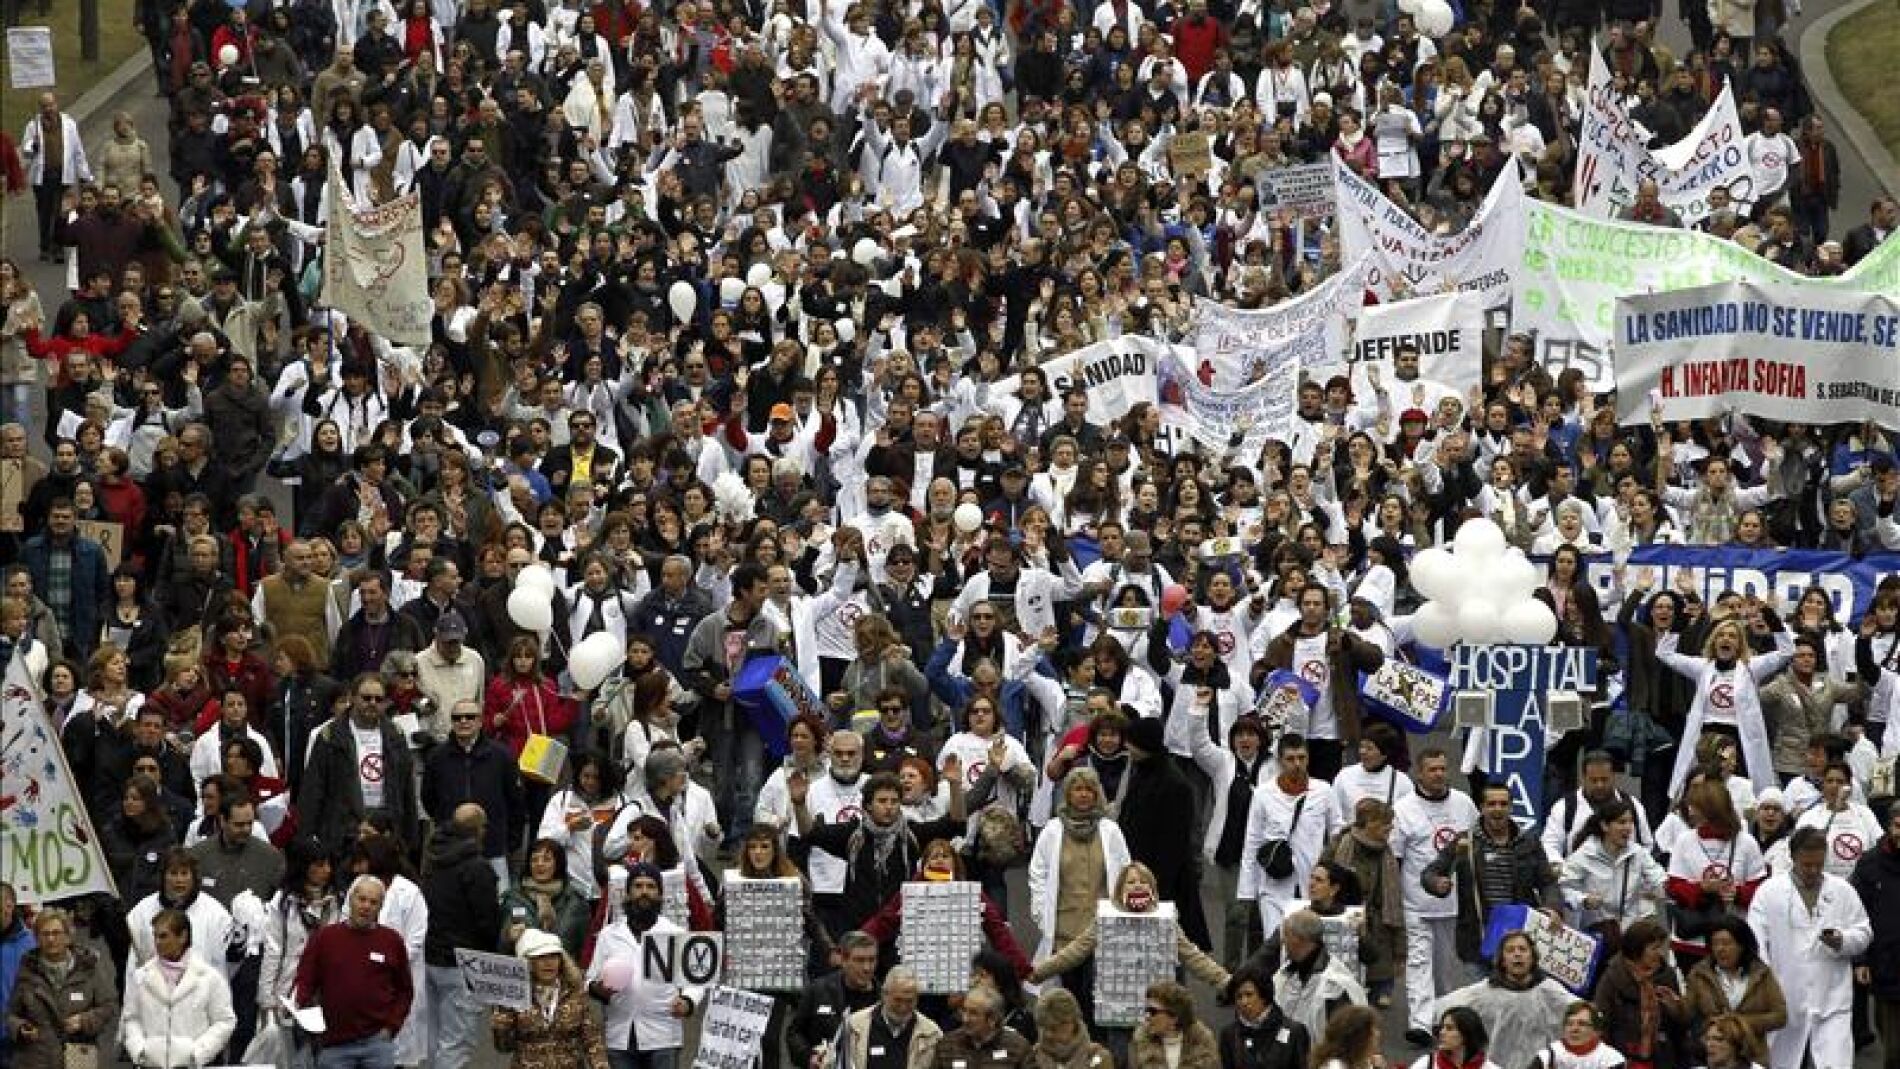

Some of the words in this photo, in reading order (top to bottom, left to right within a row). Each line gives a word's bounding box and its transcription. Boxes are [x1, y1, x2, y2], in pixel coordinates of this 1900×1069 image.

[1627, 315, 1649, 344] LA
[1653, 303, 1737, 341] SANIDAD
[1743, 301, 1767, 334] NO
[1773, 306, 1796, 338] SE
[1801, 308, 1868, 345] VENDE,
[1874, 315, 1899, 348] SE
[1661, 365, 1680, 398] H.
[1684, 358, 1749, 396] INFANTA
[1450, 644, 1597, 692] HOSPITAL
[0, 802, 91, 894] MOS
[643, 935, 718, 984] NO
